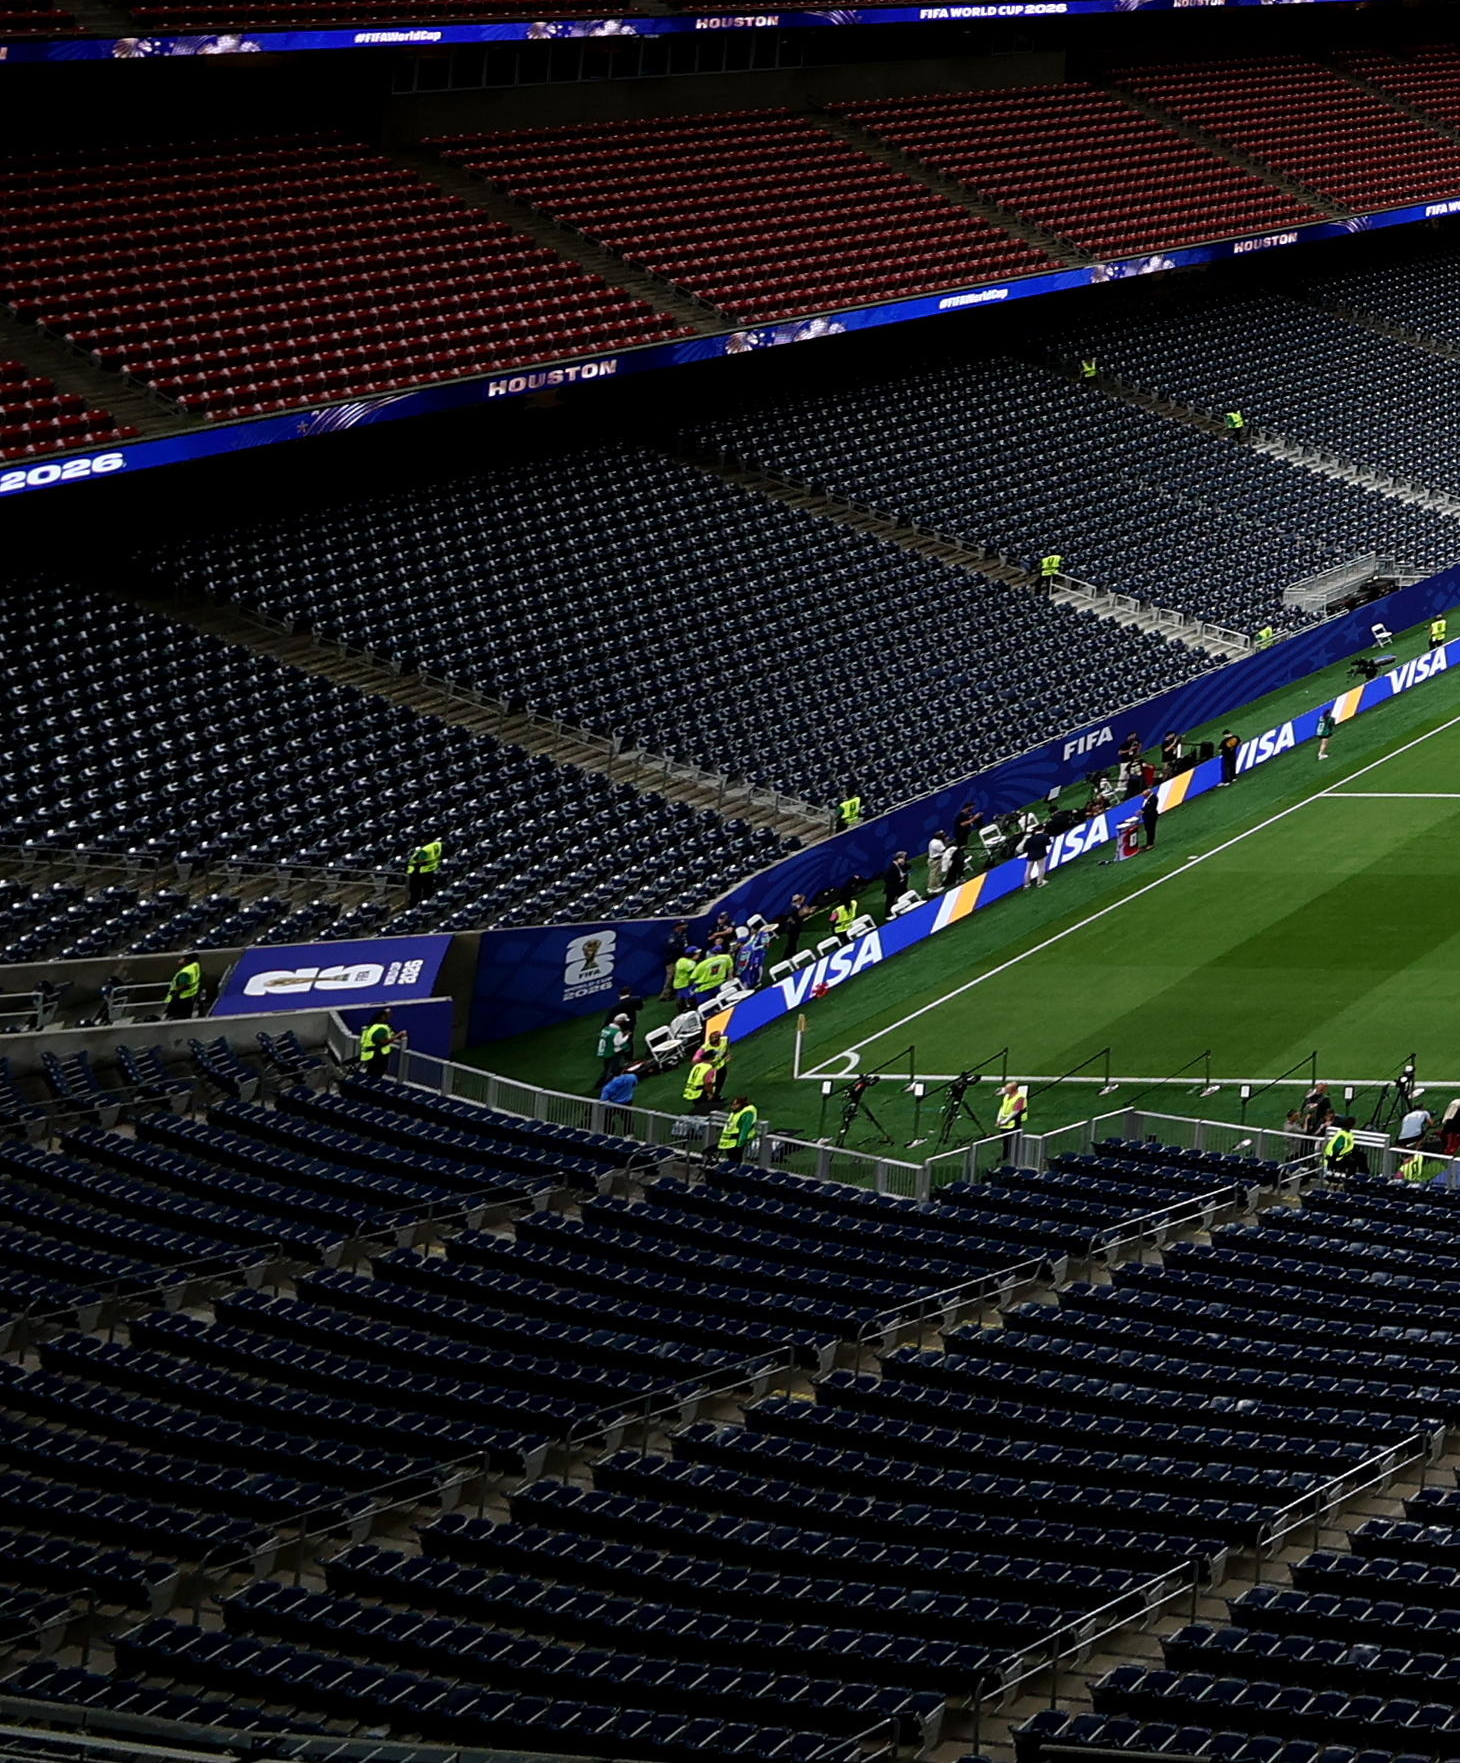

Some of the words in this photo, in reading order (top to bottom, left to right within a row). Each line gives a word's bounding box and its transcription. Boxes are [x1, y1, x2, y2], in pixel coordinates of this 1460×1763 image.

[695, 15, 779, 30] HOUSTON
[920, 8, 947, 20] FIFA
[950, 6, 997, 17] WORLD
[1000, 5, 1024, 16] CUP
[1025, 3, 1067, 14] 2026
[1426, 203, 1447, 217] FIFA
[1234, 232, 1298, 254] HOUSTON
[488, 359, 617, 397] HOUSTON
[0, 452, 125, 492] 2026
[1384, 648, 1447, 695] VISA
[1063, 726, 1113, 762] FIFA
[1030, 814, 1109, 879] ISA
[773, 930, 883, 1010] VISA
